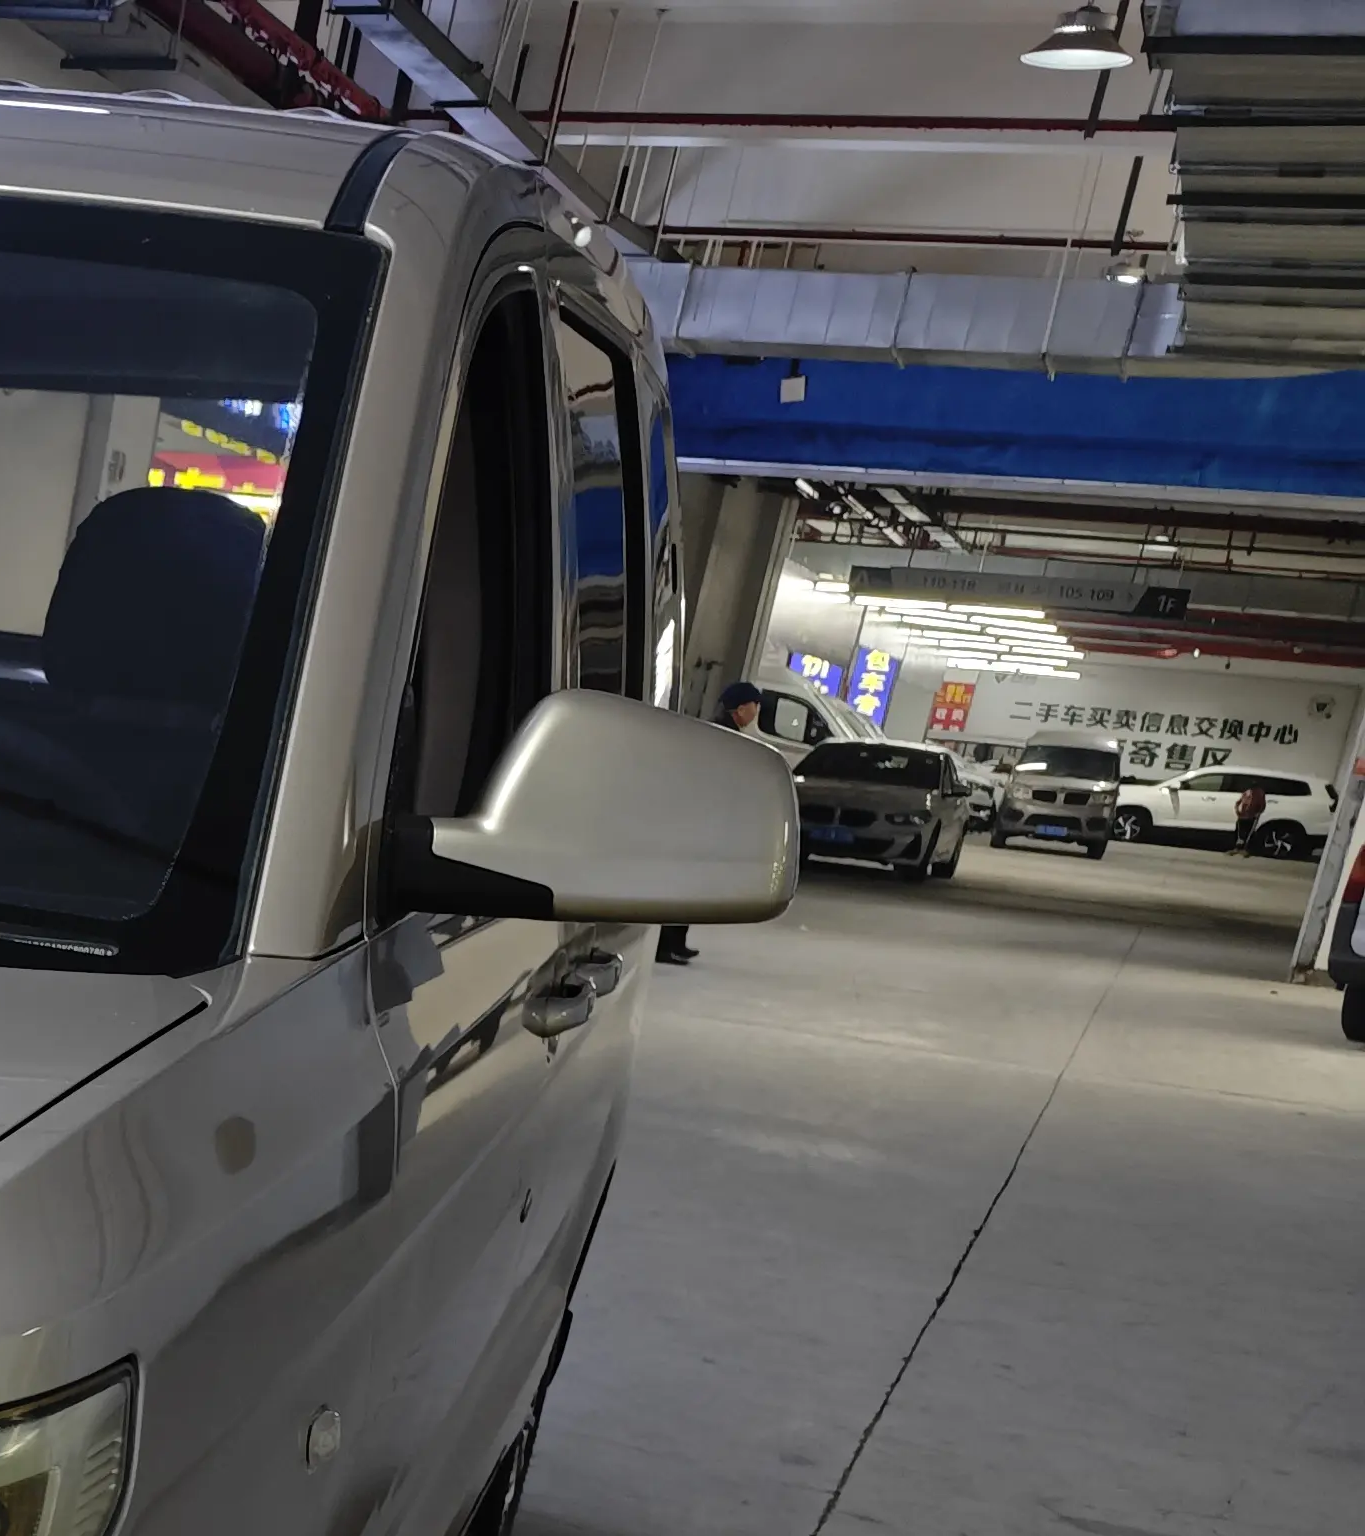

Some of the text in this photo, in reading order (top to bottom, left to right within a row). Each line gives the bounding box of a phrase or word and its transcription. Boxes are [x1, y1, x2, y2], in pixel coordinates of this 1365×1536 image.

[1009, 701, 1299, 745] 二手车买卖信息交换中心
